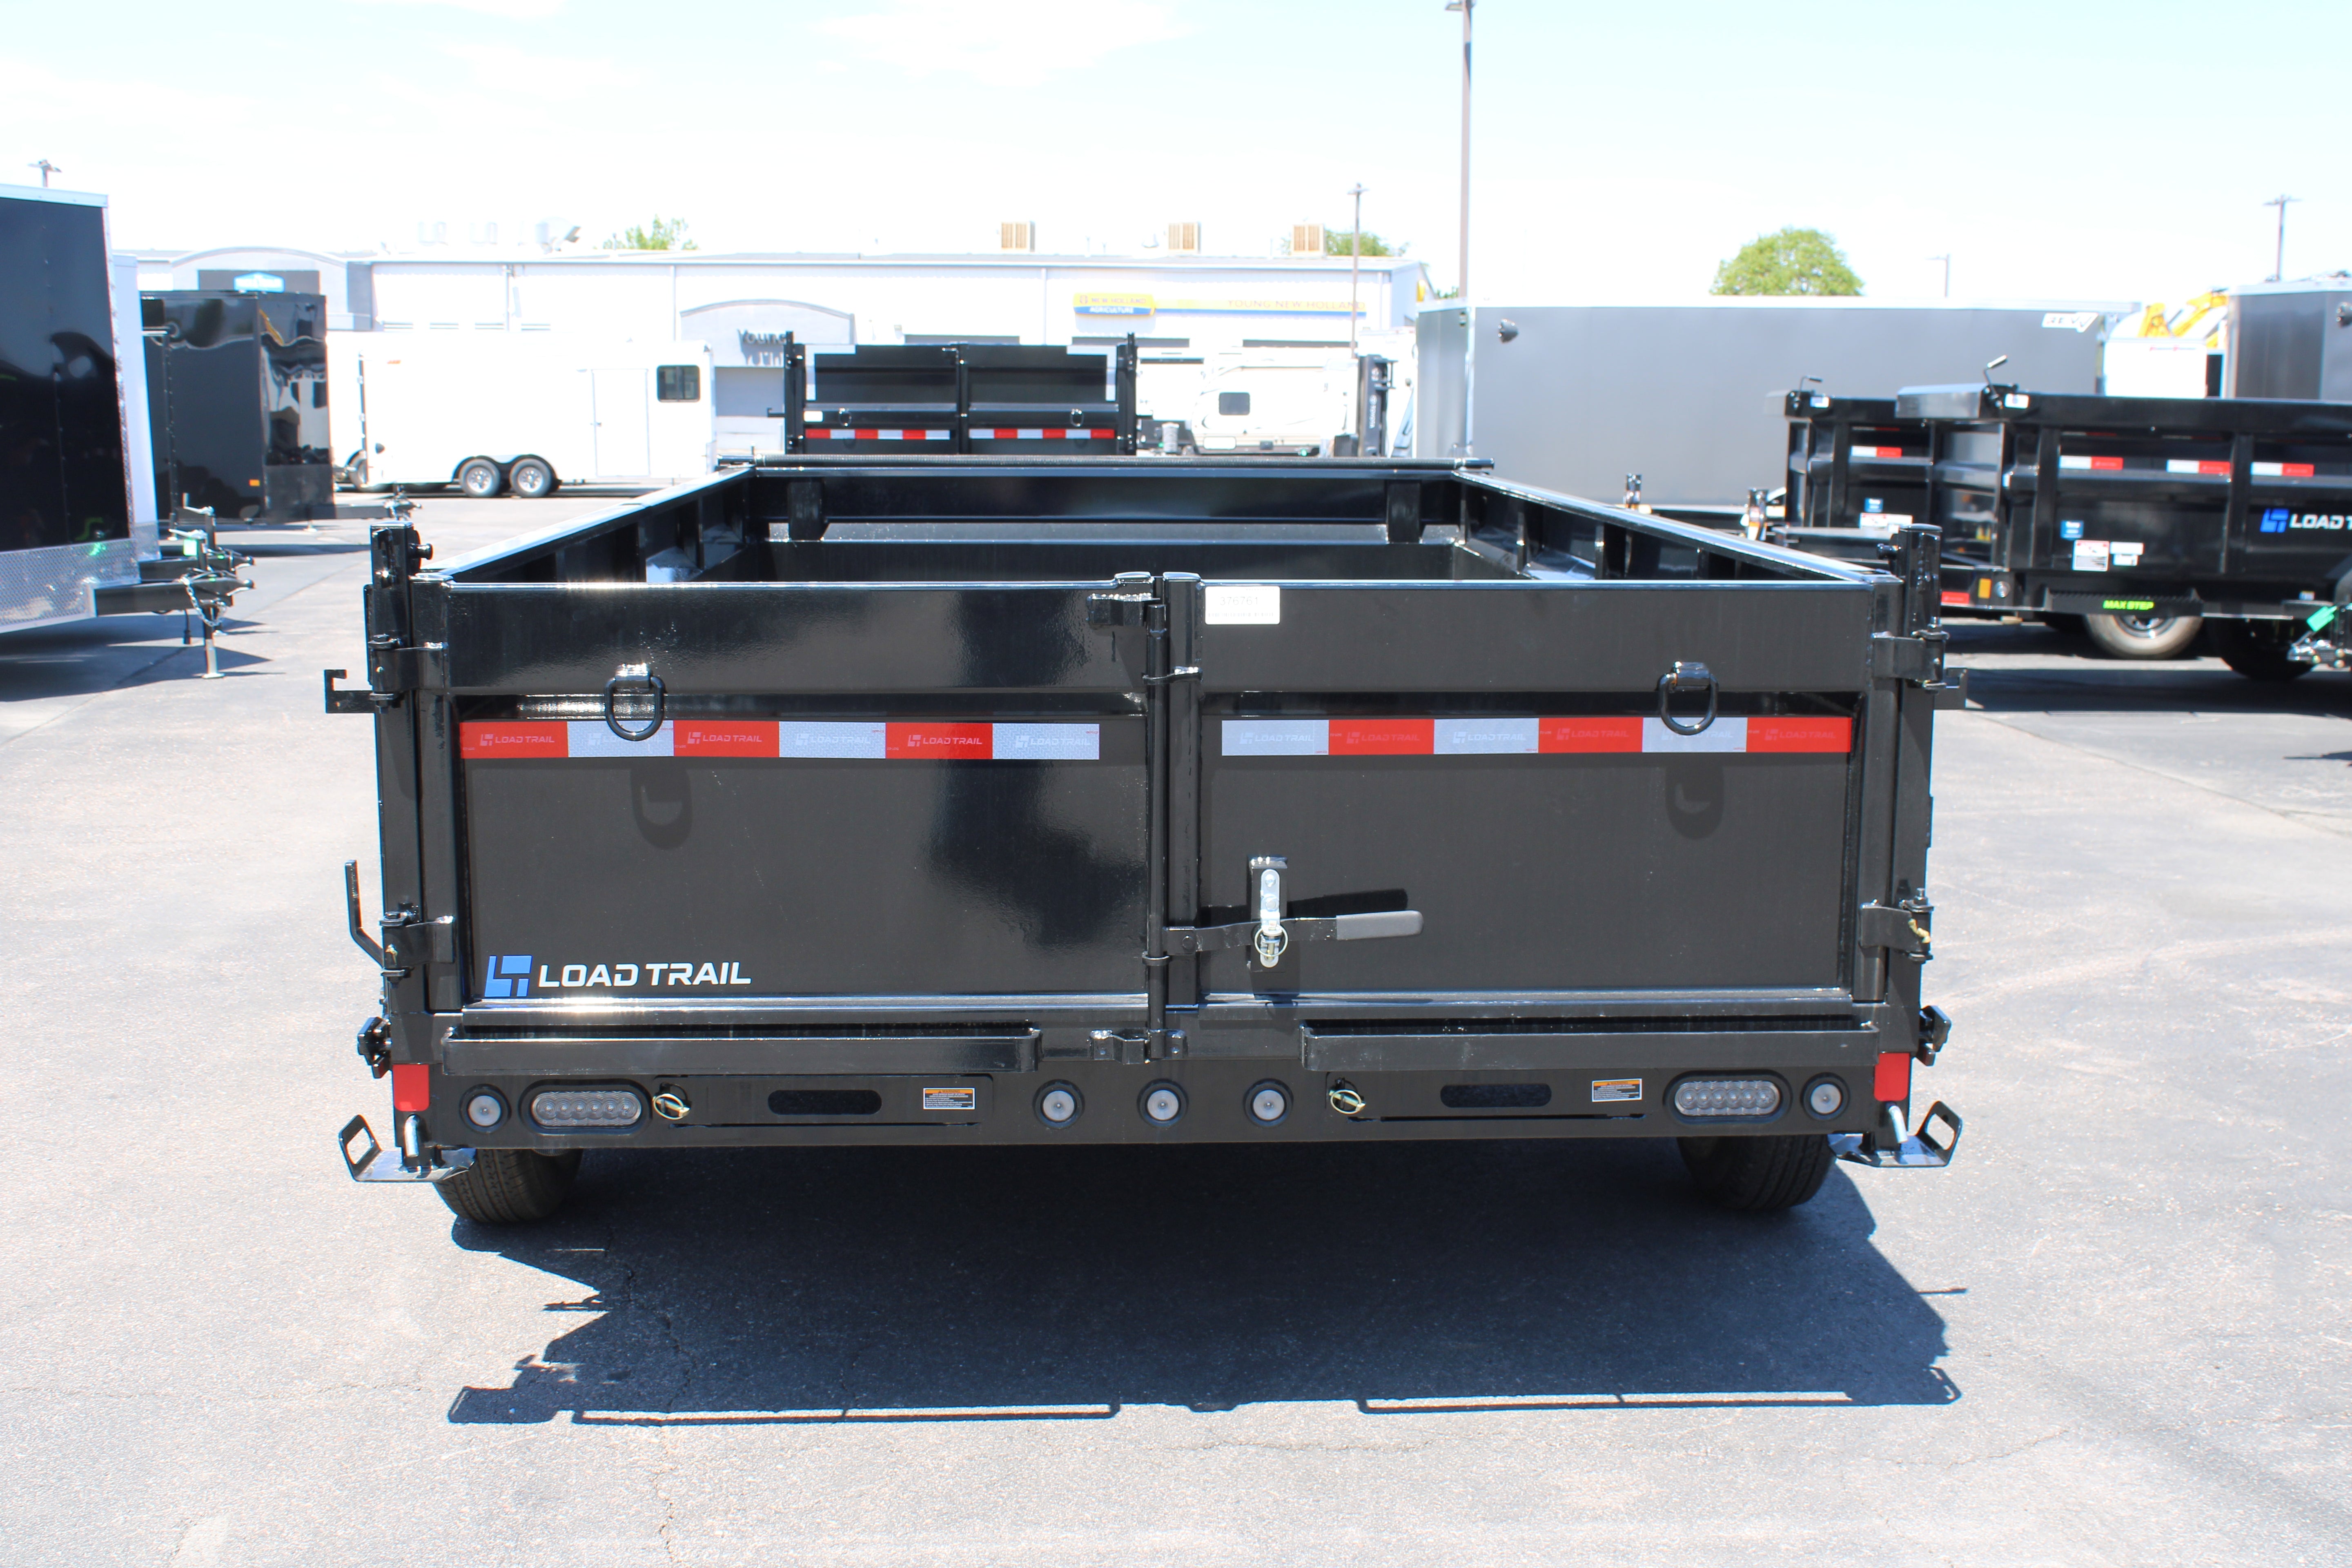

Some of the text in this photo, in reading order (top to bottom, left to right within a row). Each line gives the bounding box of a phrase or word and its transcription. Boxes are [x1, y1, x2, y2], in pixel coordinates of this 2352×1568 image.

[2289, 514, 2345, 529] LOAD
[1220, 597, 1258, 606] 376761
[2103, 600, 2154, 610] MAX STEP
[538, 963, 639, 988] LOAD
[646, 962, 752, 987] TRAIL
